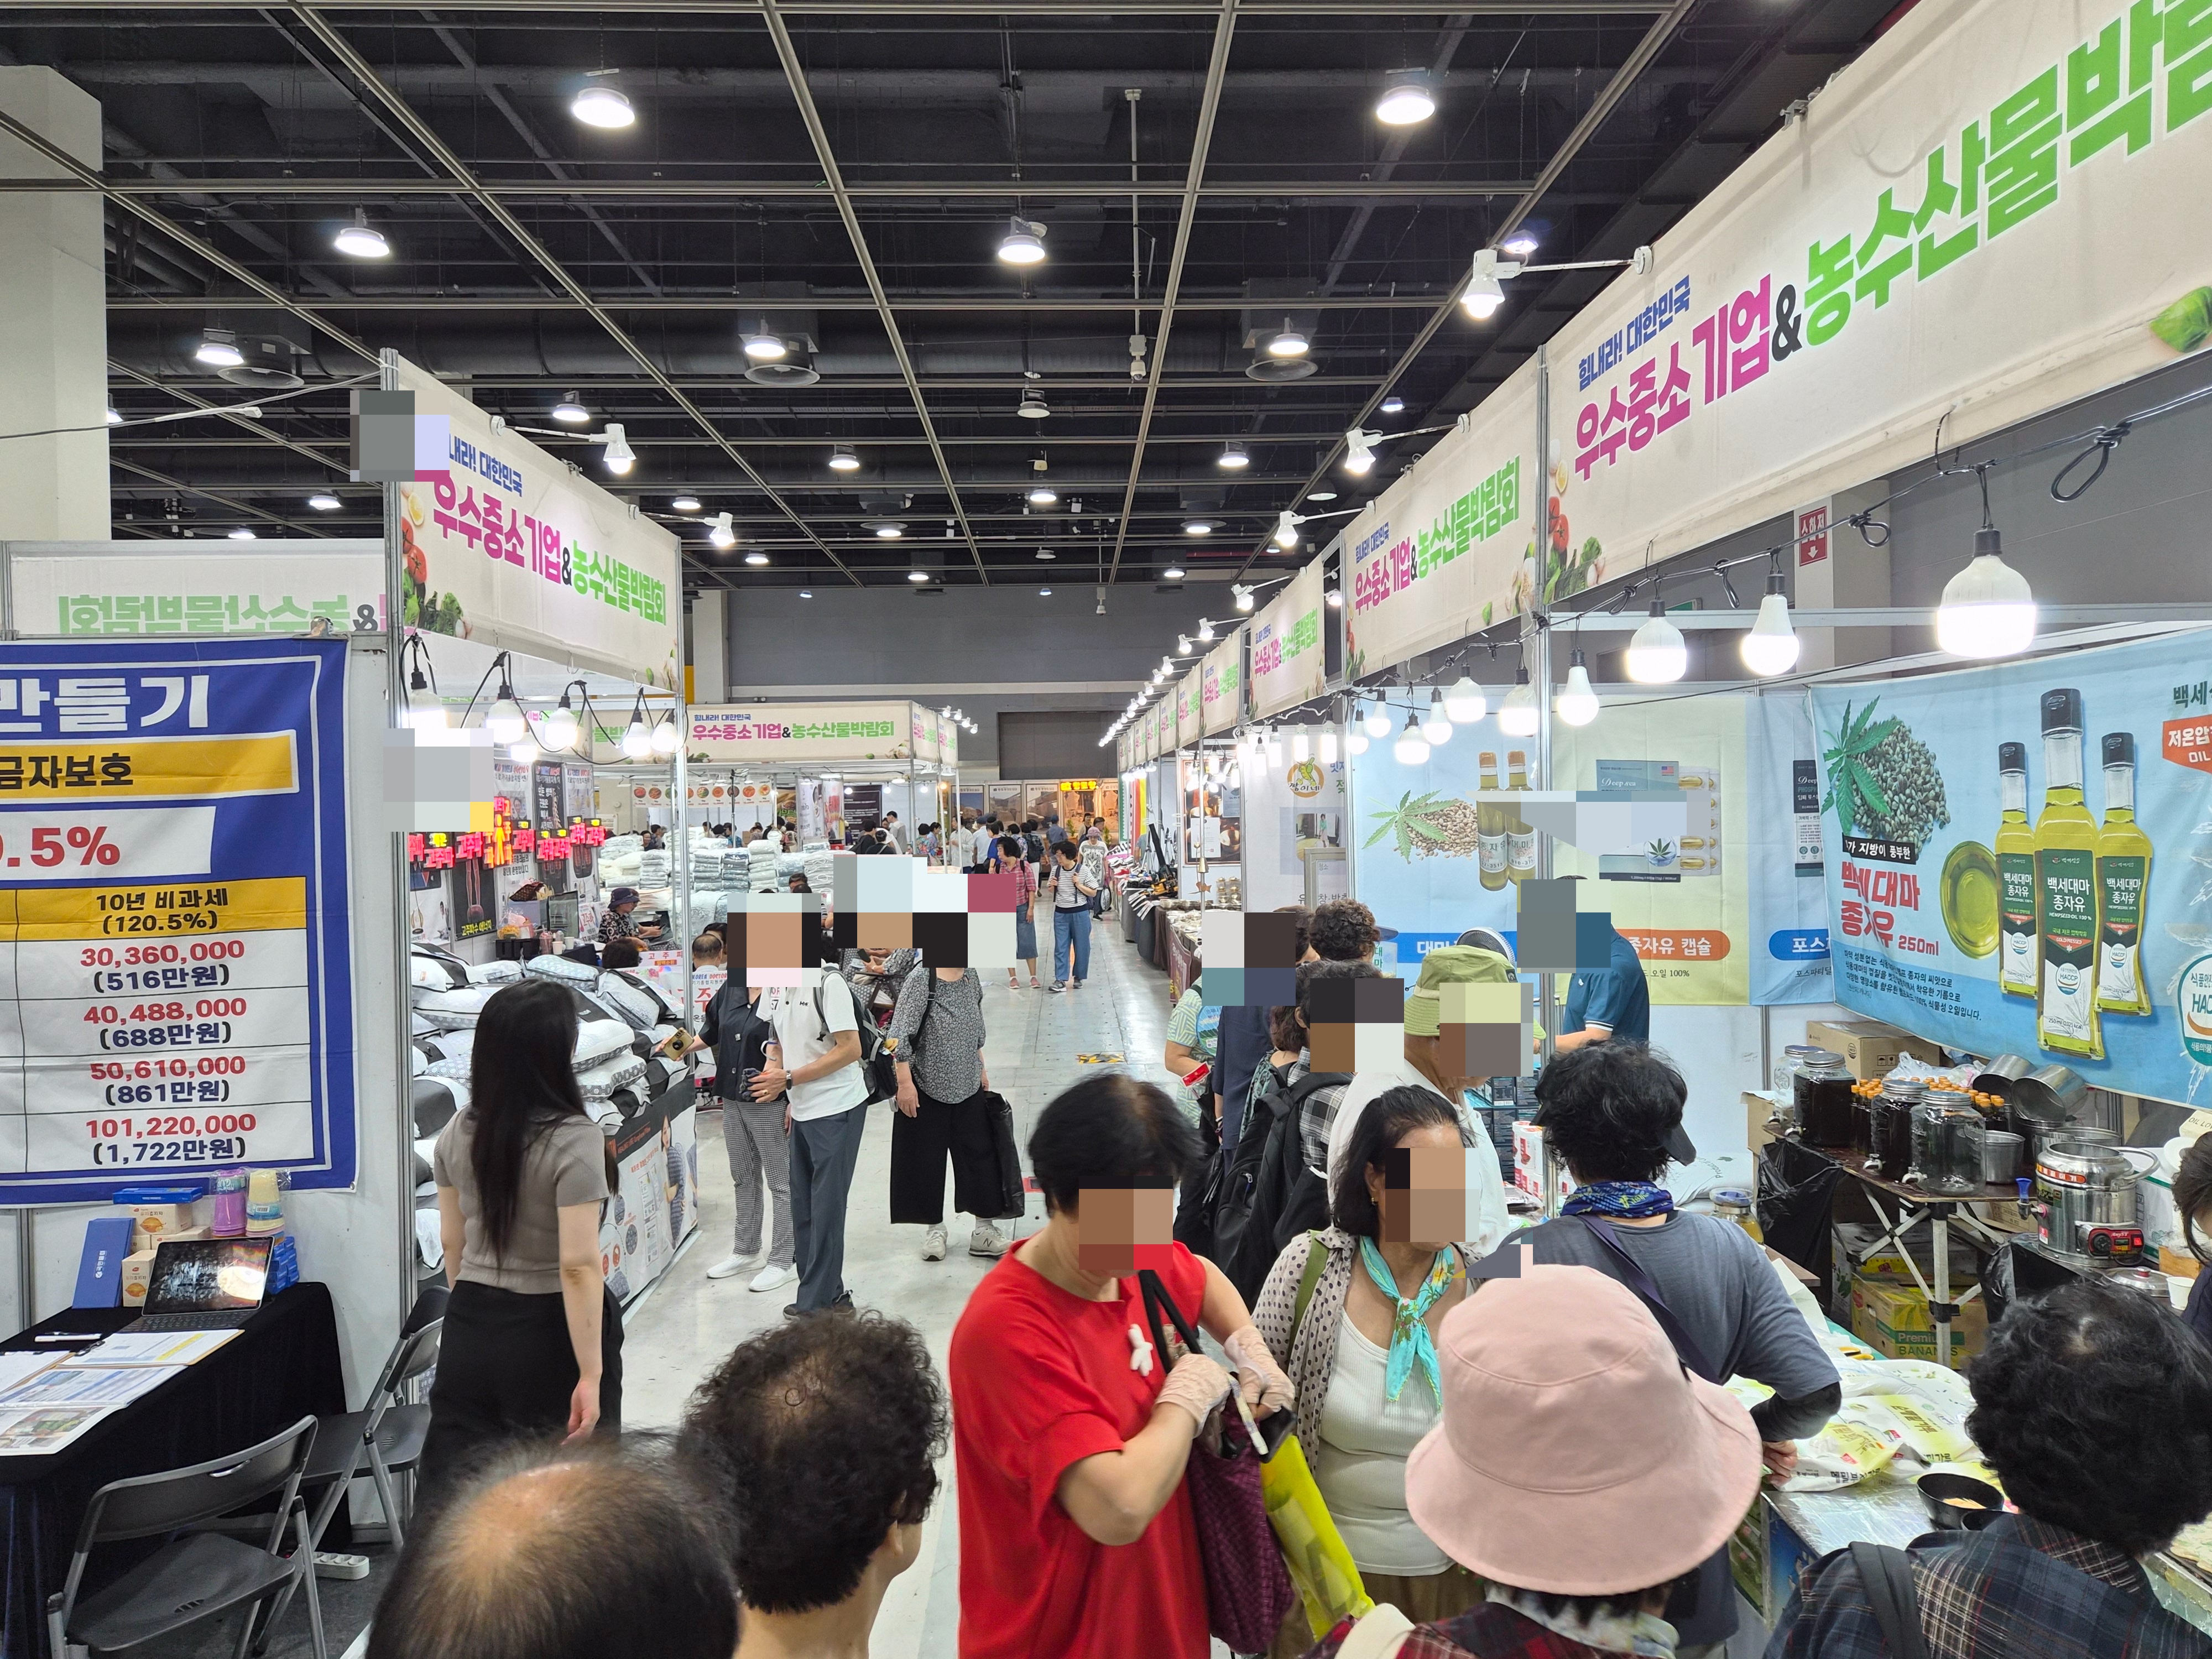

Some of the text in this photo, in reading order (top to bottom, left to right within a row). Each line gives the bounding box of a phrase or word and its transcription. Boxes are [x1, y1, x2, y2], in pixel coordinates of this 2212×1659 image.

[1579, 274, 1691, 392] 힘내라! 대한민국
[450, 432, 523, 498] 내라! 대한민국
[1355, 521, 1390, 565] 힘내라! 대한민국
[2173, 681, 2212, 708] 백세
[694, 714, 719, 722] 힘내라!
[2168, 726, 2212, 748] 저온압
[1601, 777, 1624, 787] Deep
[0, 826, 121, 868] .5%
[457, 831, 484, 860] 고주파
[1859, 842, 1886, 857] 지방이
[1889, 844, 1911, 860] 풍부한
[424, 847, 455, 869] 고주파
[2004, 872, 2033, 886] 백세대마
[2047, 877, 2090, 896] 백세대마
[2106, 877, 2142, 892] 백세대마
[96, 887, 229, 912] 10년 비과세
[2007, 885, 2030, 898] 종자유
[2112, 891, 2136, 905] 종자유
[2053, 894, 2086, 913] 종자유
[103, 910, 219, 935] (120.5%)
[80, 940, 246, 968] 30,360,000
[1681, 937, 1712, 956] 캡슐
[1898, 934, 1939, 956] 250ml
[94, 964, 229, 993] (516만원)
[1650, 969, 1667, 978] 오일
[1865, 955, 1878, 967] 없는
[1907, 971, 1927, 983] 종자의
[1928, 975, 1953, 988] 씨앗으로
[1916, 985, 1935, 997] 착유한
[1936, 989, 1961, 1003] 기름으로
[84, 997, 247, 1025] 40,488,000
[1928, 1000, 1947, 1013] 식물성
[1947, 1005, 1983, 1021] 오일입니다.
[100, 1021, 232, 1051] (688만원)
[90, 1055, 246, 1082] 50,610,000
[106, 1079, 230, 1106] (861만원)
[86, 1113, 257, 1140] 101,220,000
[2188, 1117, 2200, 1125] OIL
[93, 1138, 246, 1165] (1,722만원)
[1898, 1332, 1937, 1343] Premiu
[1898, 1346, 1958, 1356] BANANS
